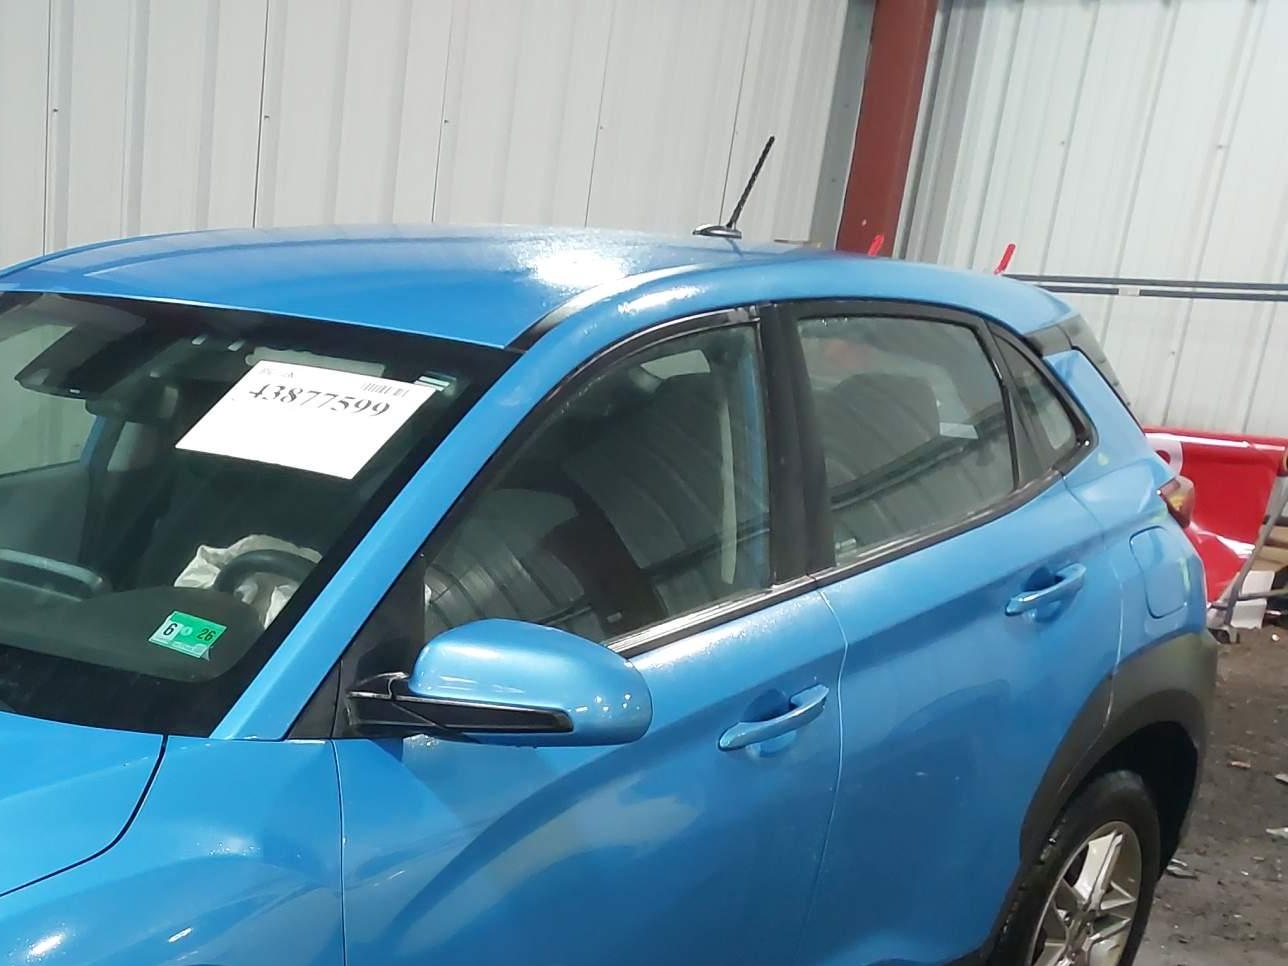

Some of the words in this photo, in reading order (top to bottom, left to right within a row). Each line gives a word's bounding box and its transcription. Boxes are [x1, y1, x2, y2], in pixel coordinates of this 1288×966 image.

[248, 383, 392, 417] 43877599
[163, 623, 178, 636] 6
[197, 628, 216, 641] 26
